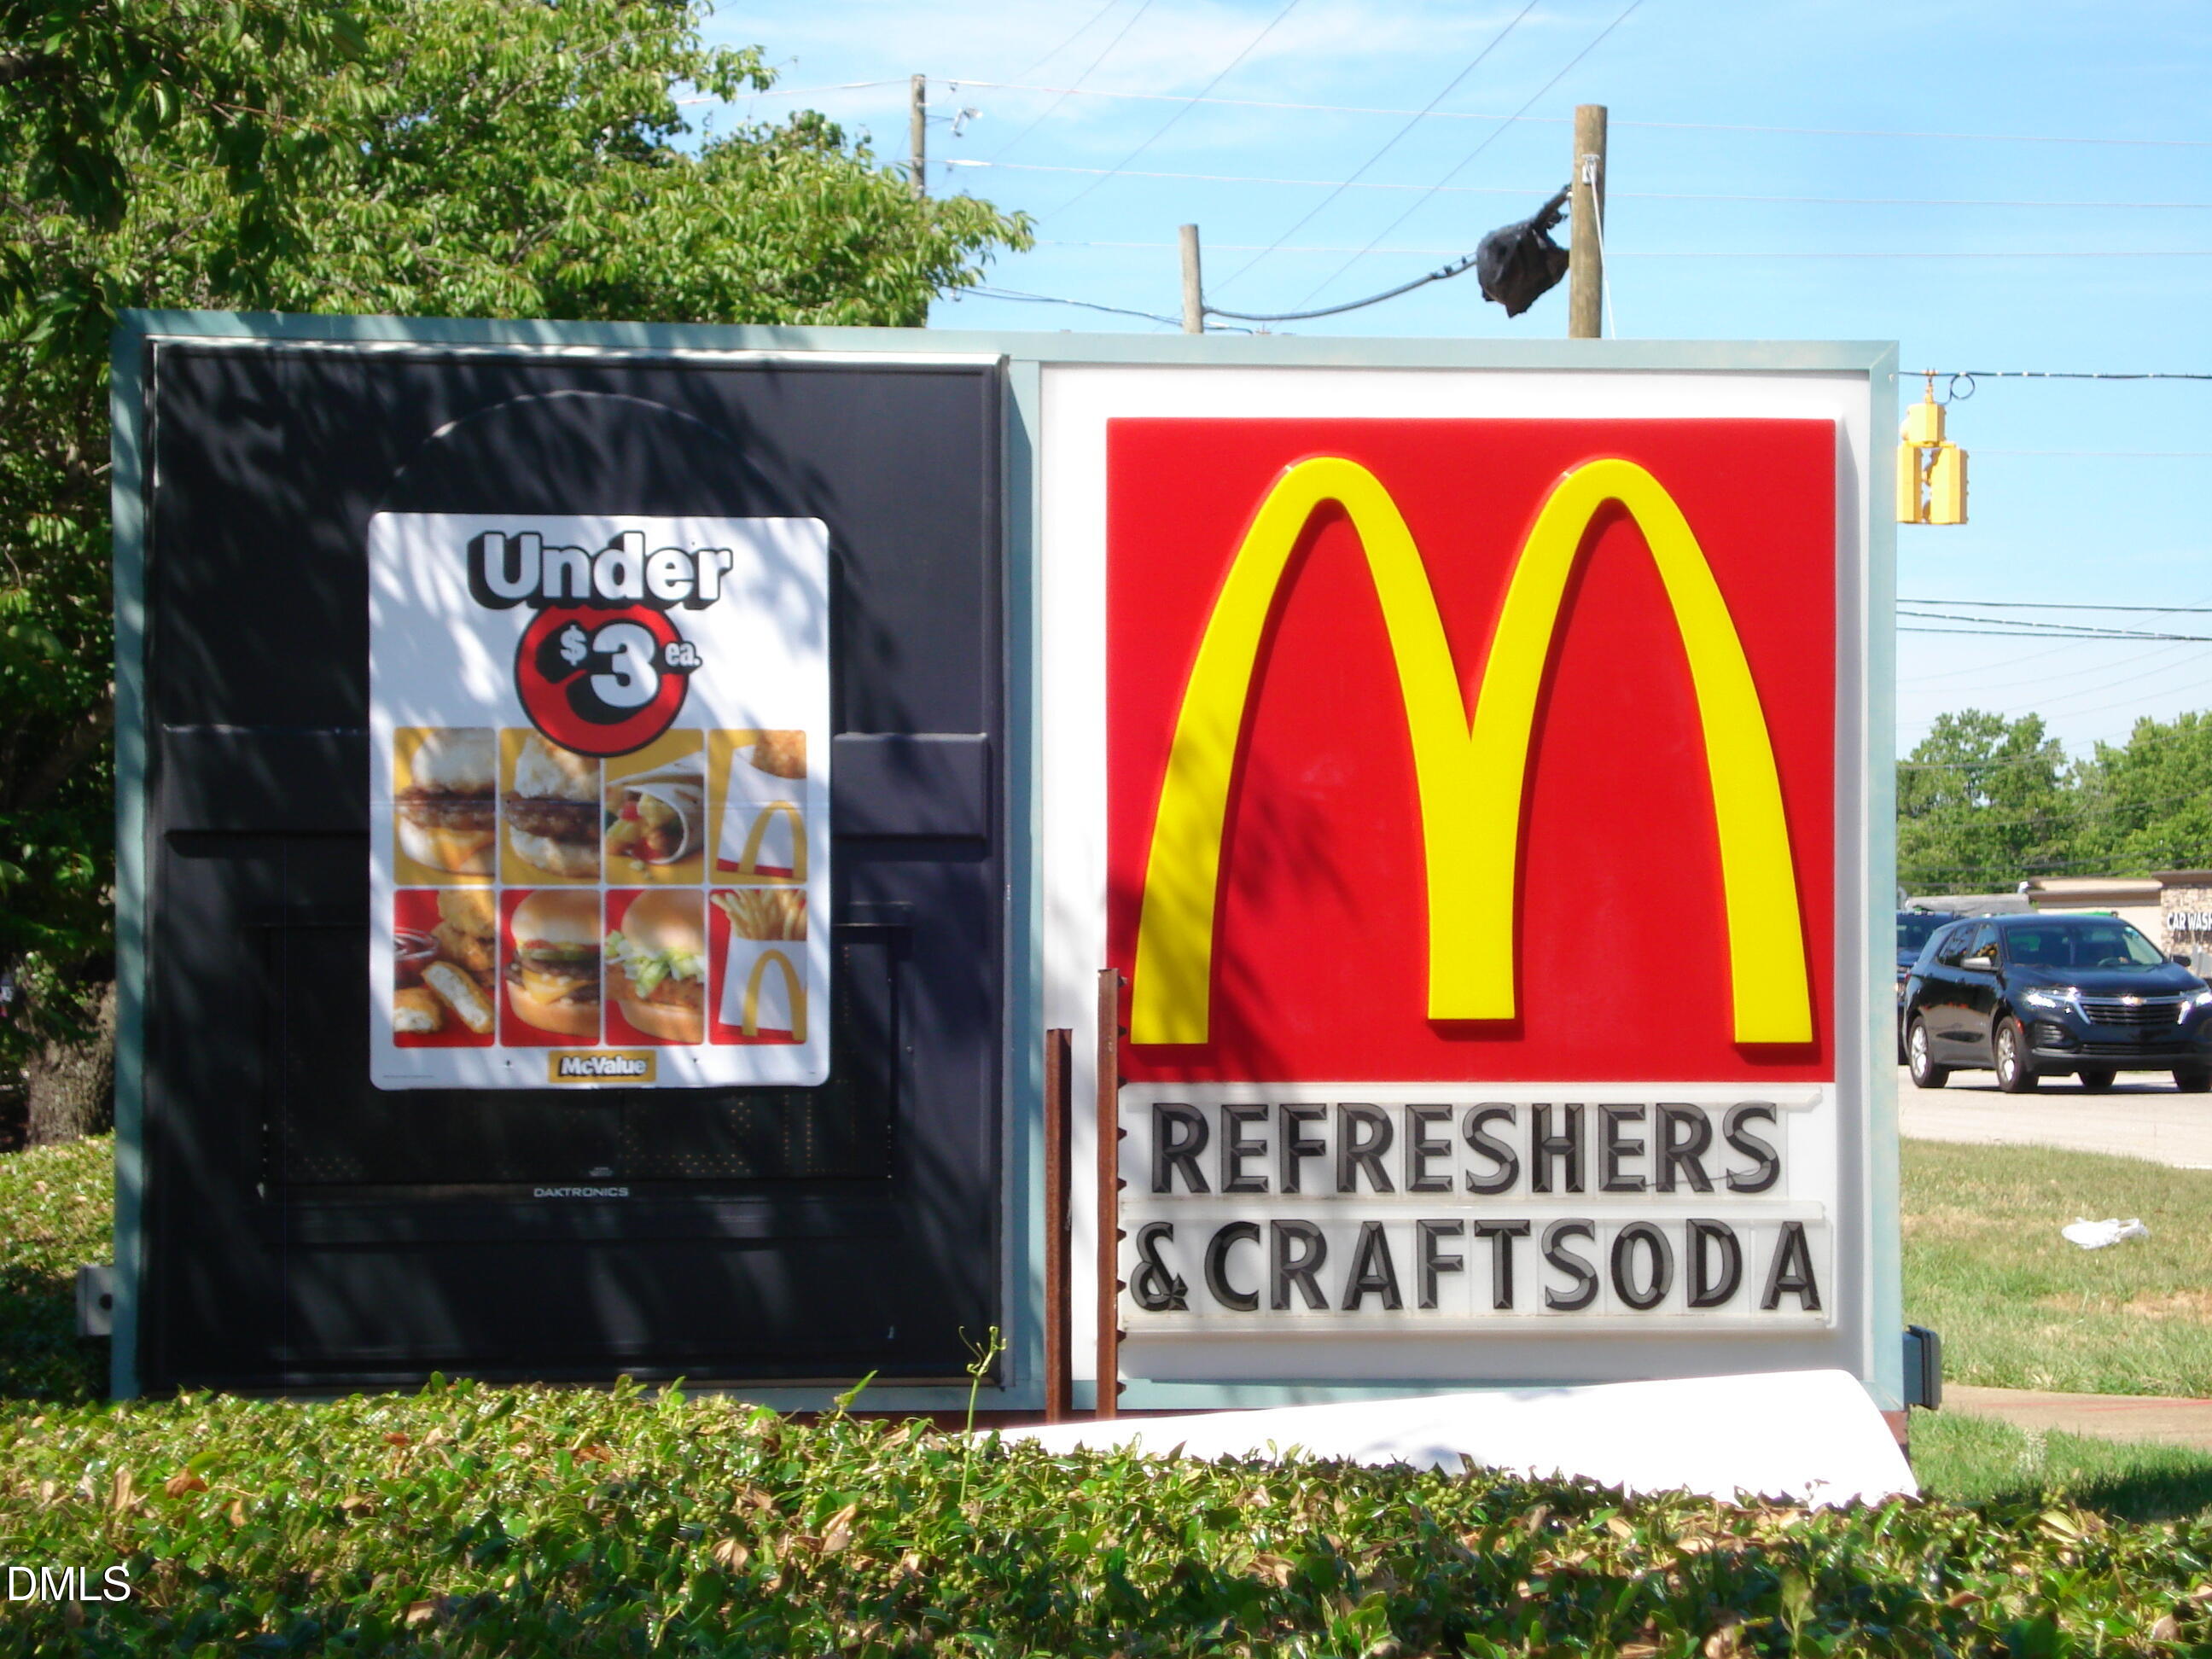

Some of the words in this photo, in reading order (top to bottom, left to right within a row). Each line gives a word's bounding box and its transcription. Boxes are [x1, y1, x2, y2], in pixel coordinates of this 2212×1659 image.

[467, 531, 733, 609] Under
[665, 640, 703, 669] ea.
[2168, 912, 2186, 931] CAR
[559, 1055, 647, 1077] McValue
[1152, 1103, 1778, 1194] REFRESHERS
[533, 1187, 629, 1197] DAKTRONICS
